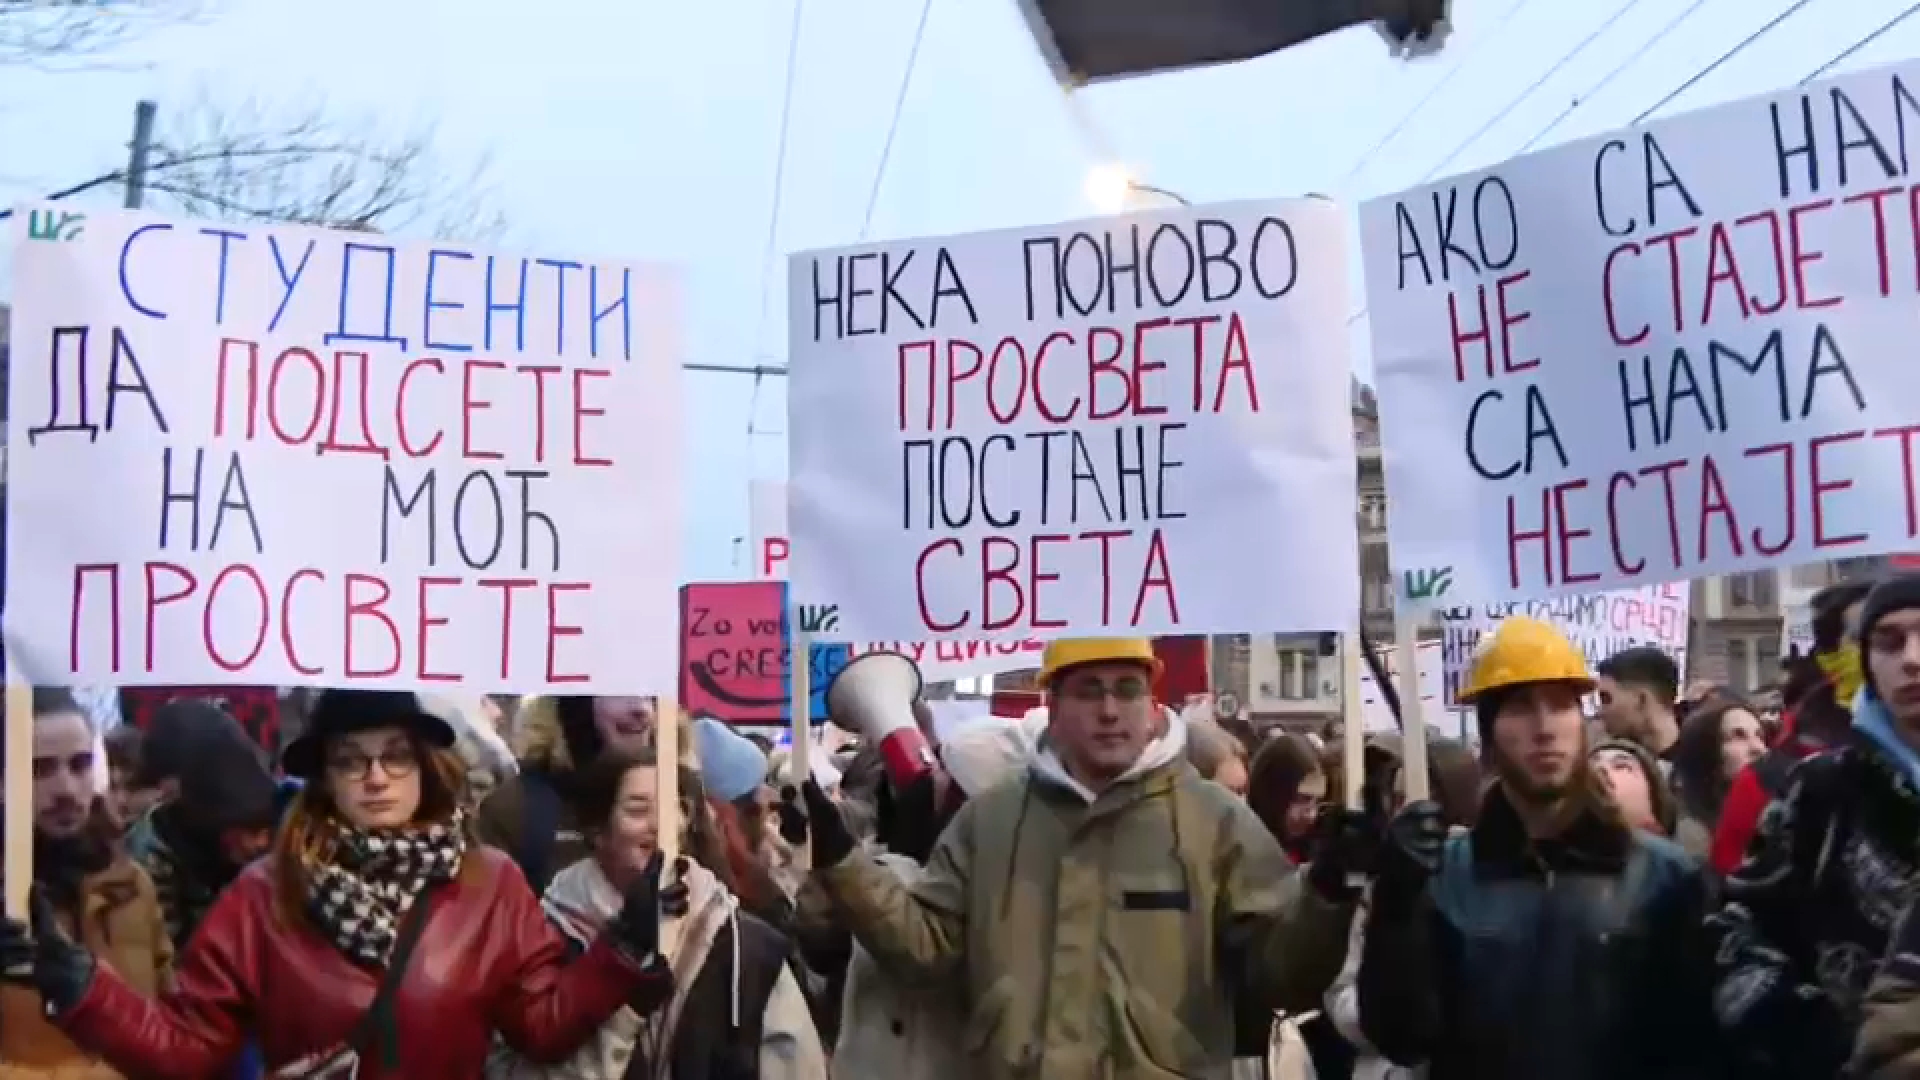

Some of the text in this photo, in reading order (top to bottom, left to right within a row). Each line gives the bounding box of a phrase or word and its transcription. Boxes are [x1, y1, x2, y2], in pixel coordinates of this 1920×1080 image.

[1395, 175, 1518, 290] АКО
[1594, 132, 1702, 236] СА
[119, 225, 630, 359] СТУДЕНТИ
[813, 217, 1297, 341] НЕКА ПОНОВО
[1448, 187, 1920, 382] НЕ СТАЈЕТ
[28, 326, 612, 466] ДА ПОДСЕТЕ
[898, 312, 1260, 431] ПРОСВЕТА
[1465, 323, 1867, 480] СА НАМА
[160, 447, 559, 571] НА МОЋ
[902, 423, 1188, 530] ПОСТАНЕ
[71, 562, 592, 682] ПРОСВЕТЕ
[916, 529, 1179, 632] СВЕТА
